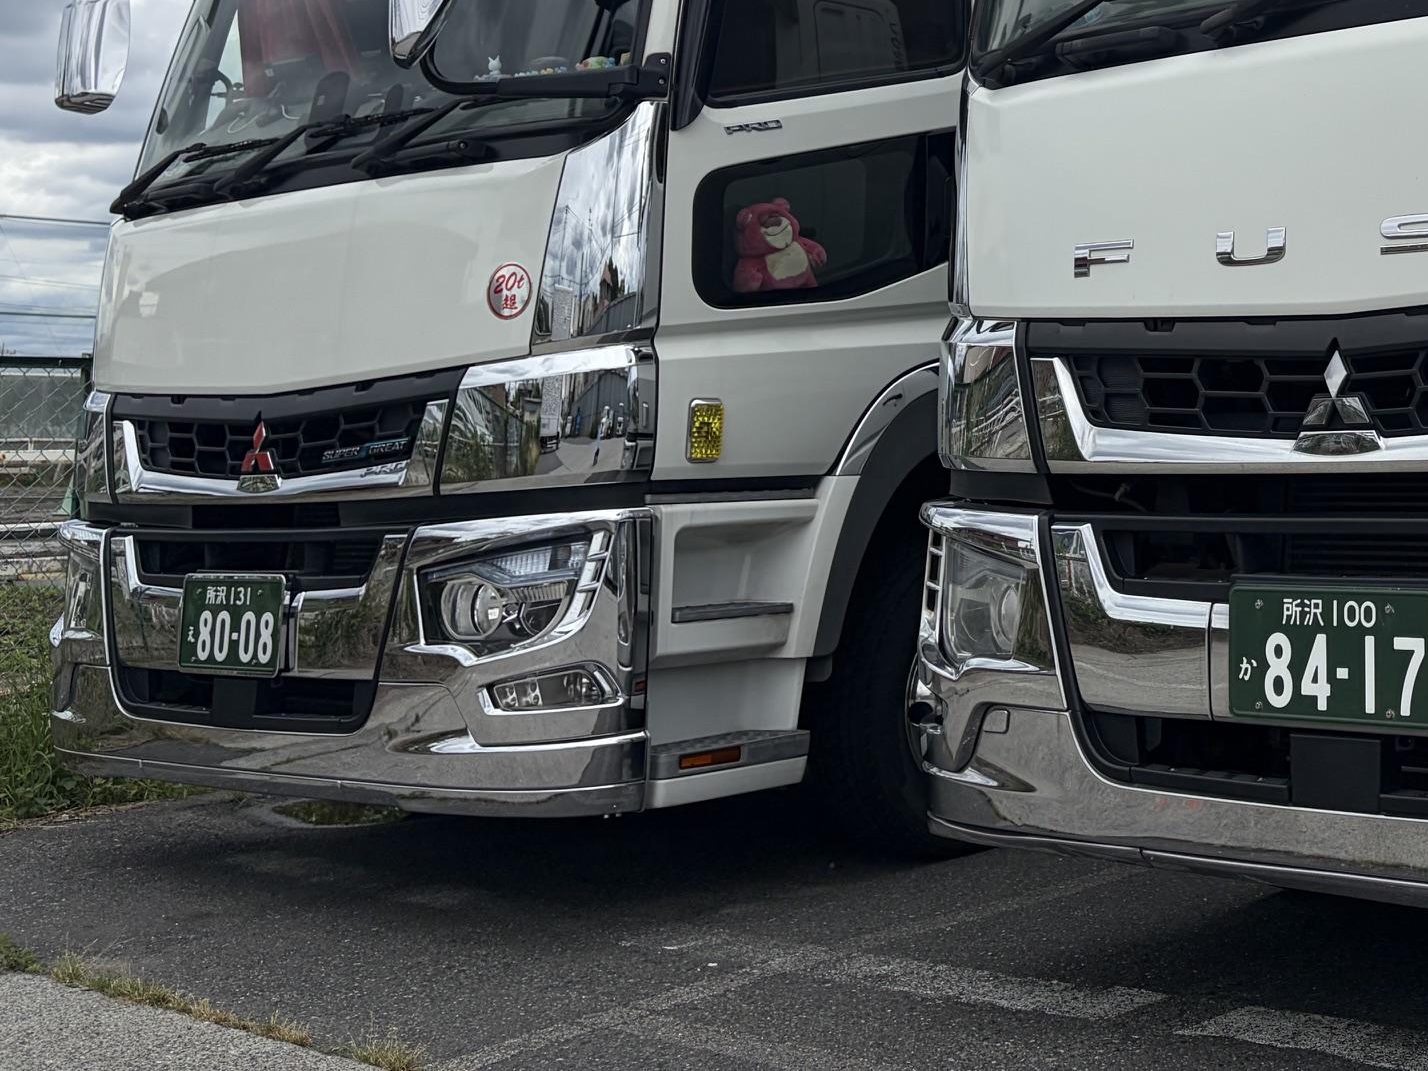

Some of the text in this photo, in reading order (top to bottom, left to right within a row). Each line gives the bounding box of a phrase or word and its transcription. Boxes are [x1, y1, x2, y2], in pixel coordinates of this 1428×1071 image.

[723, 119, 783, 136] PRO
[494, 272, 525, 295] 20t
[502, 293, 519, 310] 超
[322, 440, 409, 460] SUPER GREAT
[205, 586, 251, 606] 所沢 131
[1282, 598, 1377, 628] 所沢 100
[197, 610, 275, 664] 80-08
[1238, 632, 1425, 716] か 84-17
